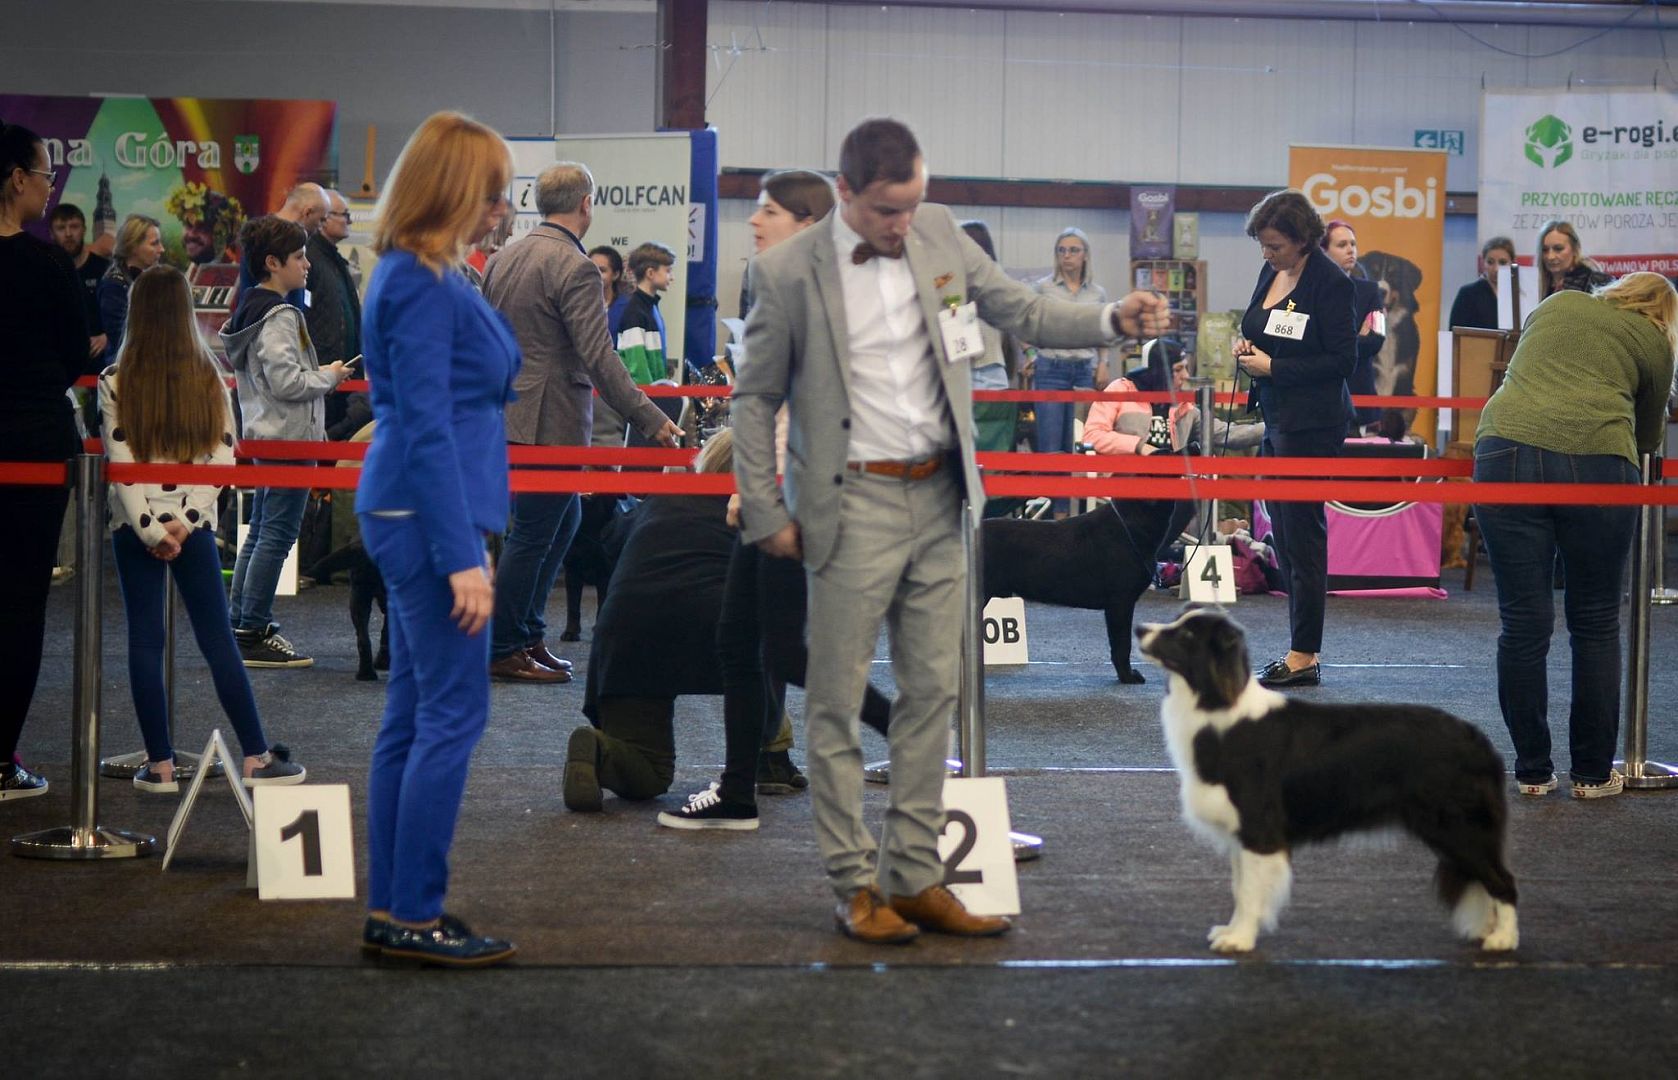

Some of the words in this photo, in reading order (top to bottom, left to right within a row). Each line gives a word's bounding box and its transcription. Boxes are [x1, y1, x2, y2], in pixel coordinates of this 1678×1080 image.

[114, 131, 221, 169] Góra
[593, 184, 685, 206] WOLFCAN
[1302, 172, 1437, 219] Gosbi
[1521, 191, 1642, 207] PRZYGOTOWANE
[1512, 214, 1529, 229] ZE
[611, 236, 628, 246] WE
[1275, 323, 1294, 335] 868
[1200, 555, 1221, 588] 4
[983, 617, 1020, 644] OB
[280, 809, 323, 876] 1
[939, 810, 983, 885] 2
